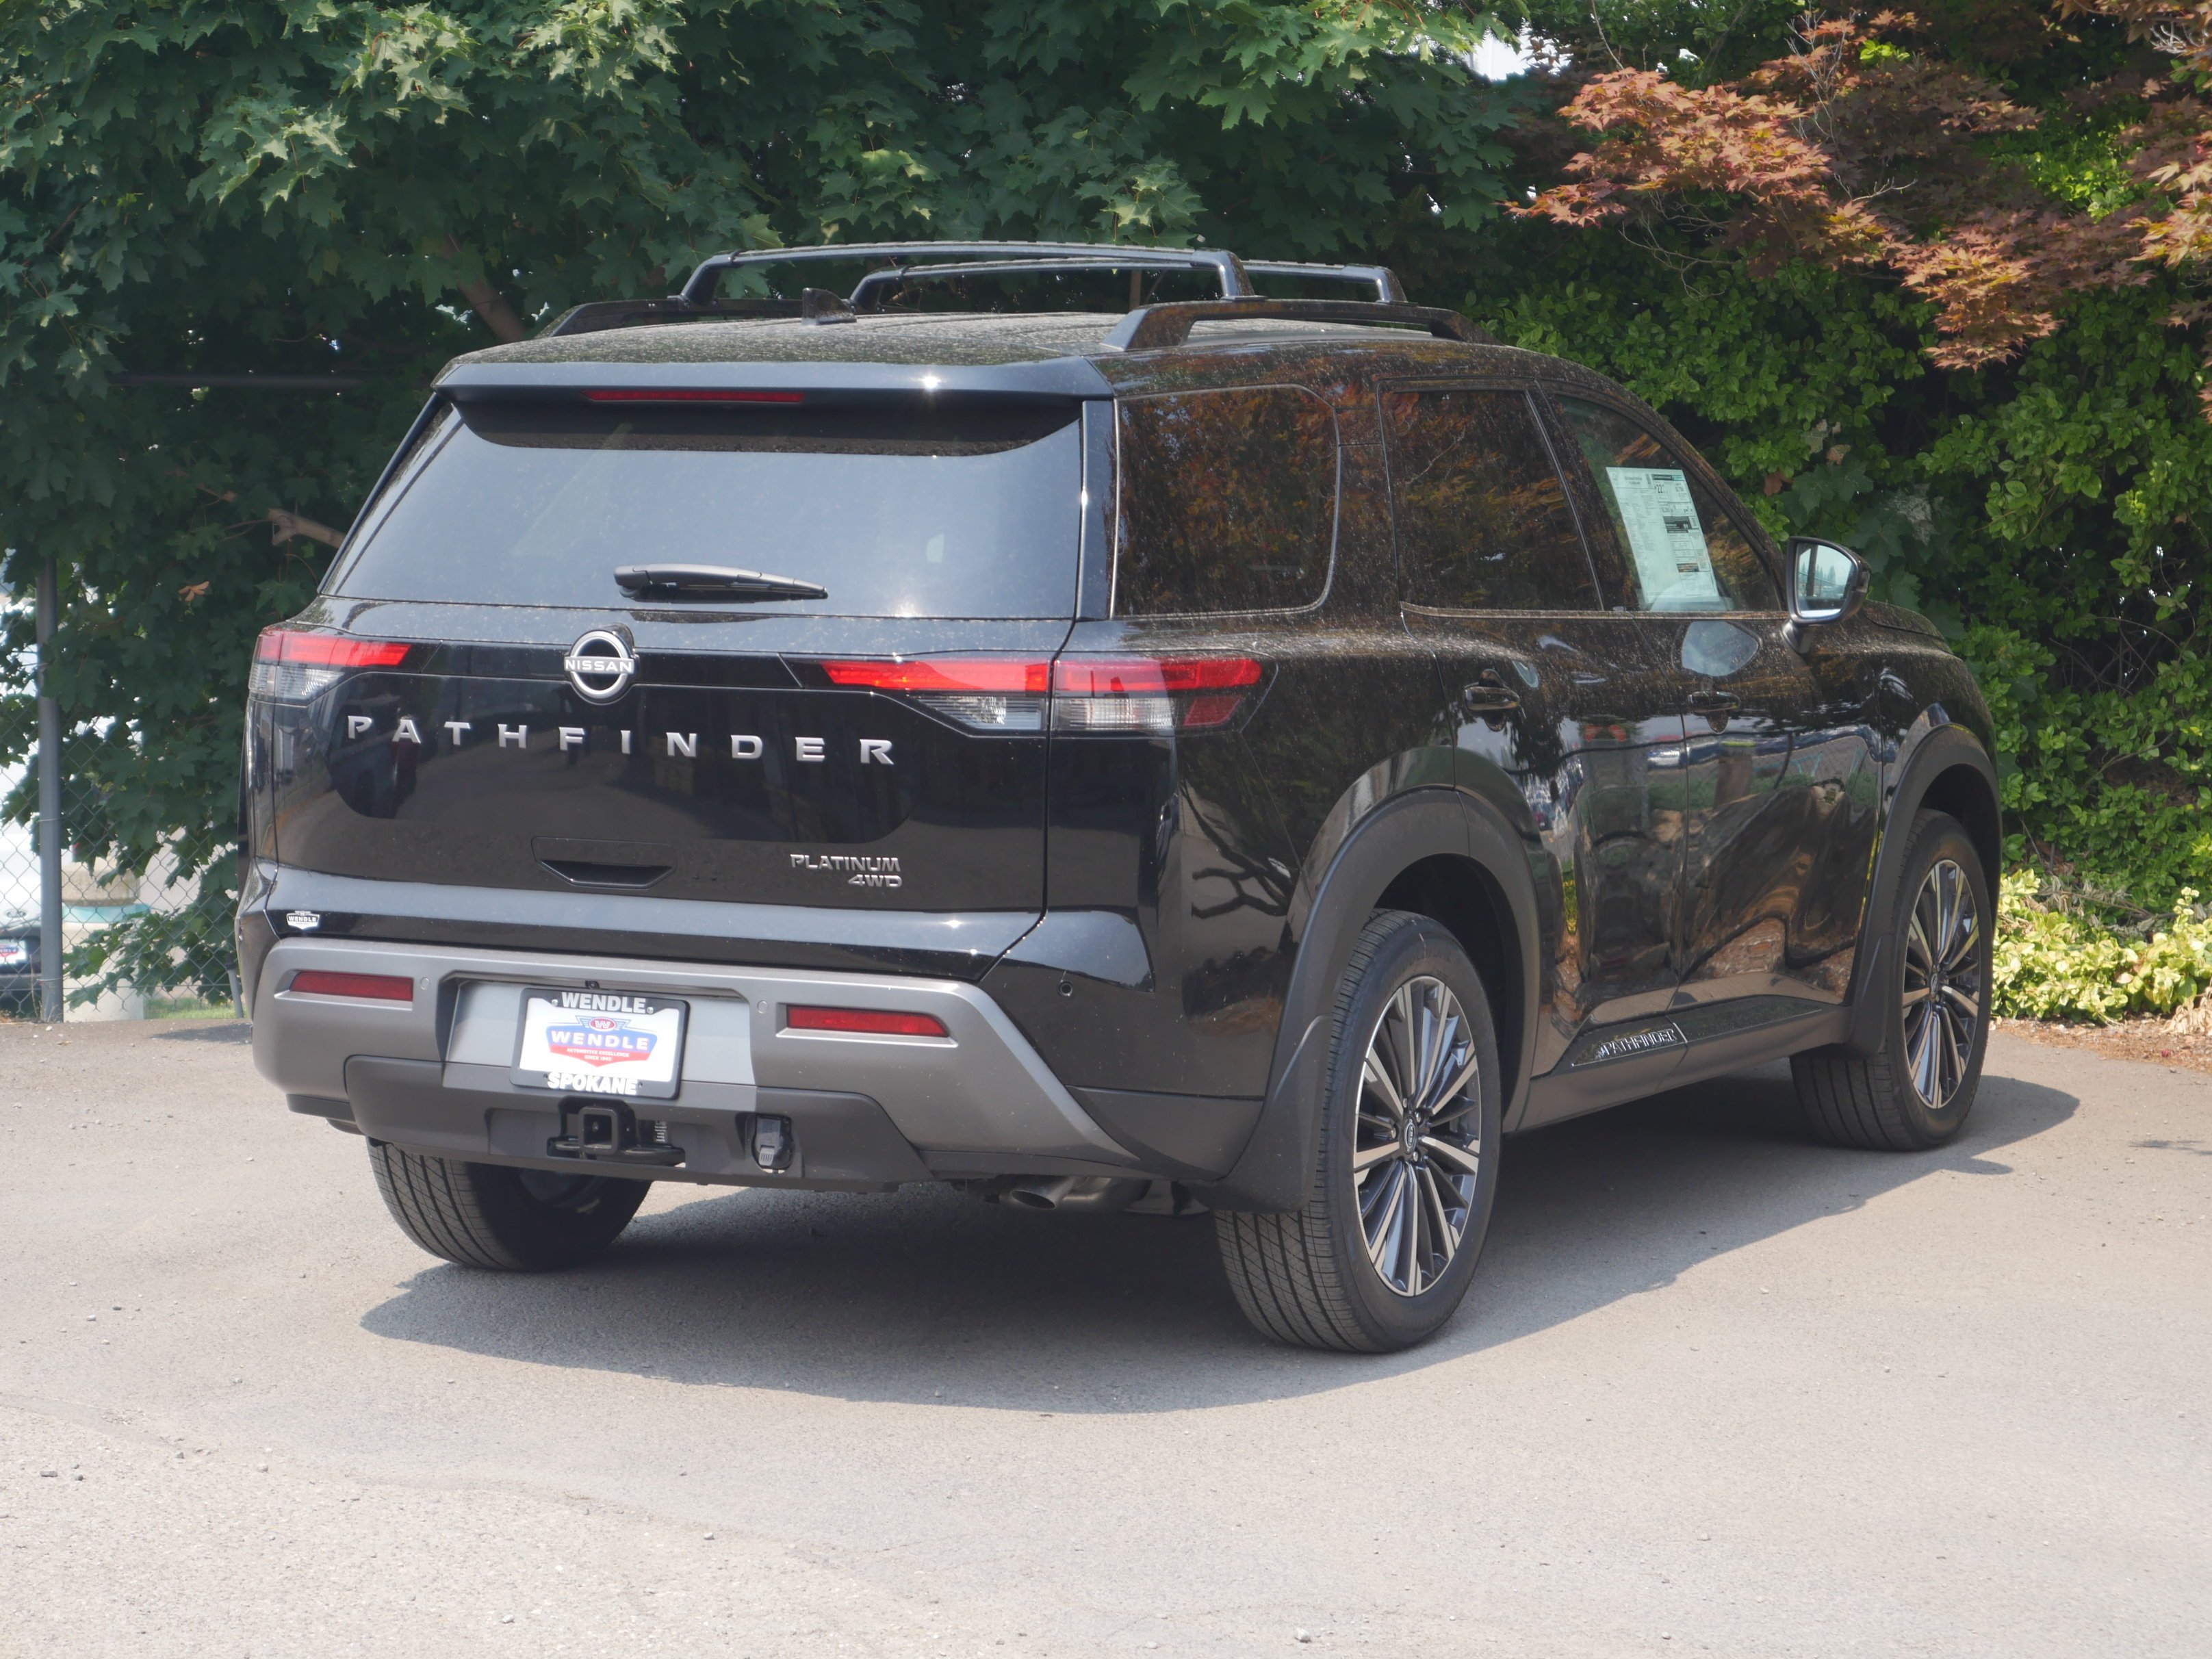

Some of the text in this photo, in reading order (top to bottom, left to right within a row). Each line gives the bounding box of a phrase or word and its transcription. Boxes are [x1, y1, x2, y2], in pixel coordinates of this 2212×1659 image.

[565, 659, 632, 672] NISSAN
[348, 715, 895, 766] PATHFINDER
[790, 854, 901, 872] PLATINUM
[848, 874, 903, 888] 4WD
[561, 992, 645, 1014] WENDLE
[552, 1031, 648, 1050] WENDLE
[1601, 1029, 1677, 1055] PATHFINDER
[548, 1072, 638, 1095] SPOKANE
